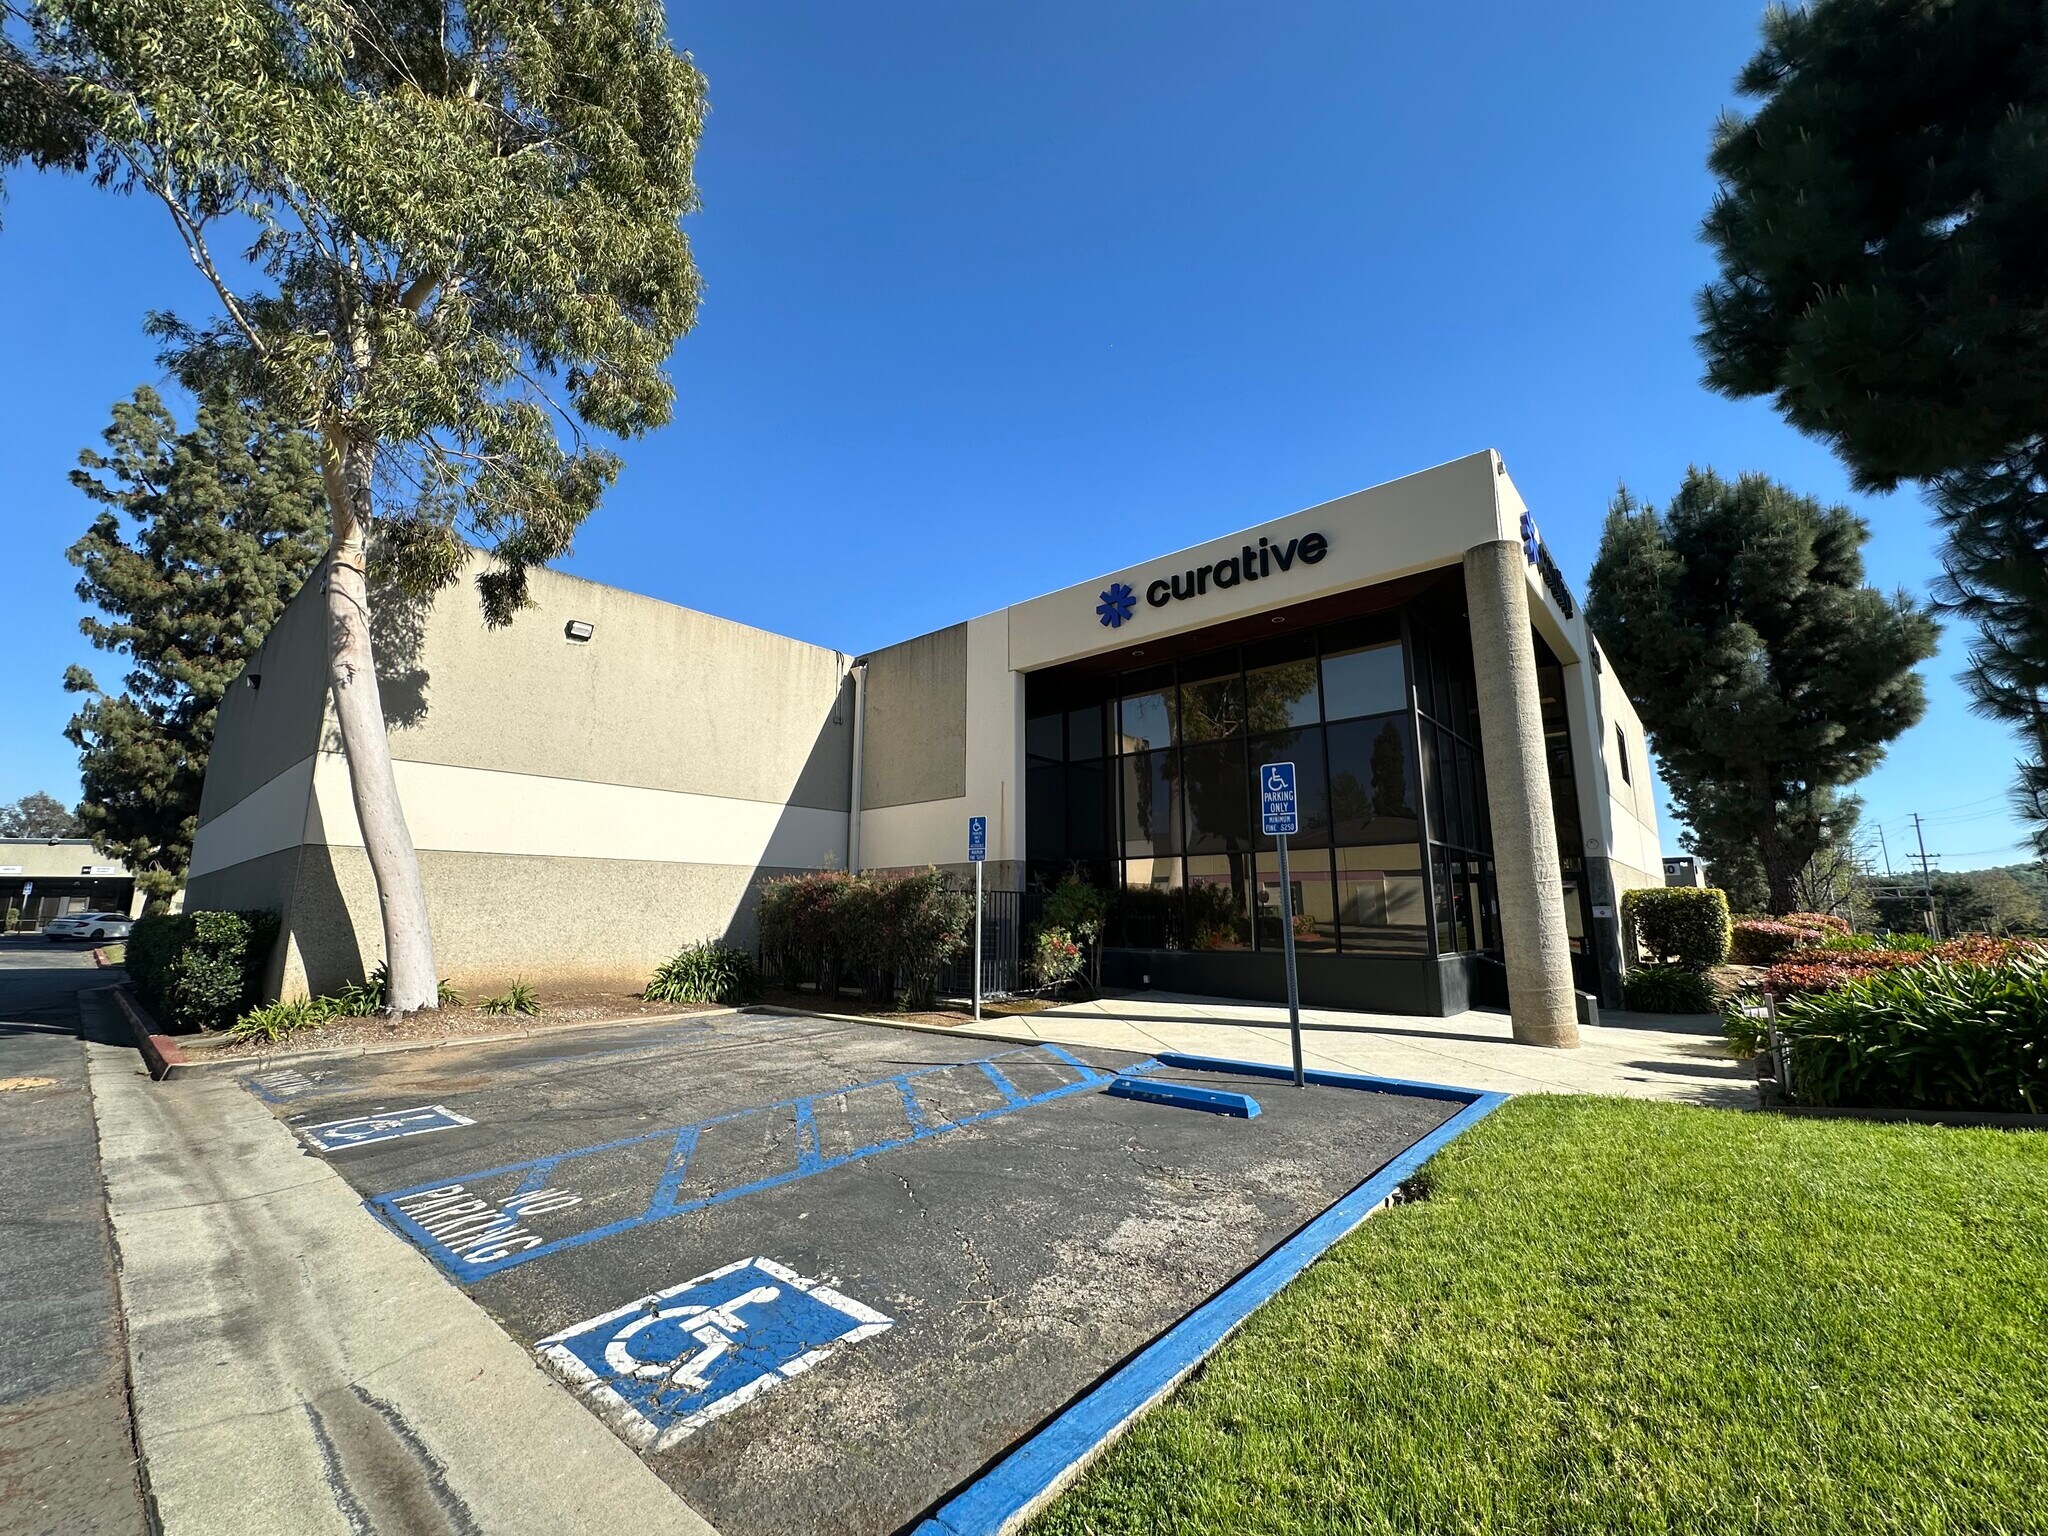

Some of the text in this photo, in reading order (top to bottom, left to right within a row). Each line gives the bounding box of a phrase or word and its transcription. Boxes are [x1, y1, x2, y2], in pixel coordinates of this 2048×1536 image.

[1146, 532, 1328, 607] curative
[1264, 790, 1294, 802] PARKING
[1270, 802, 1288, 813] ONLY
[1268, 815, 1291, 823] MINIMUM
[1280, 823, 1295, 831] $250
[497, 1187, 583, 1216] NO
[392, 1184, 543, 1264] PARKING
